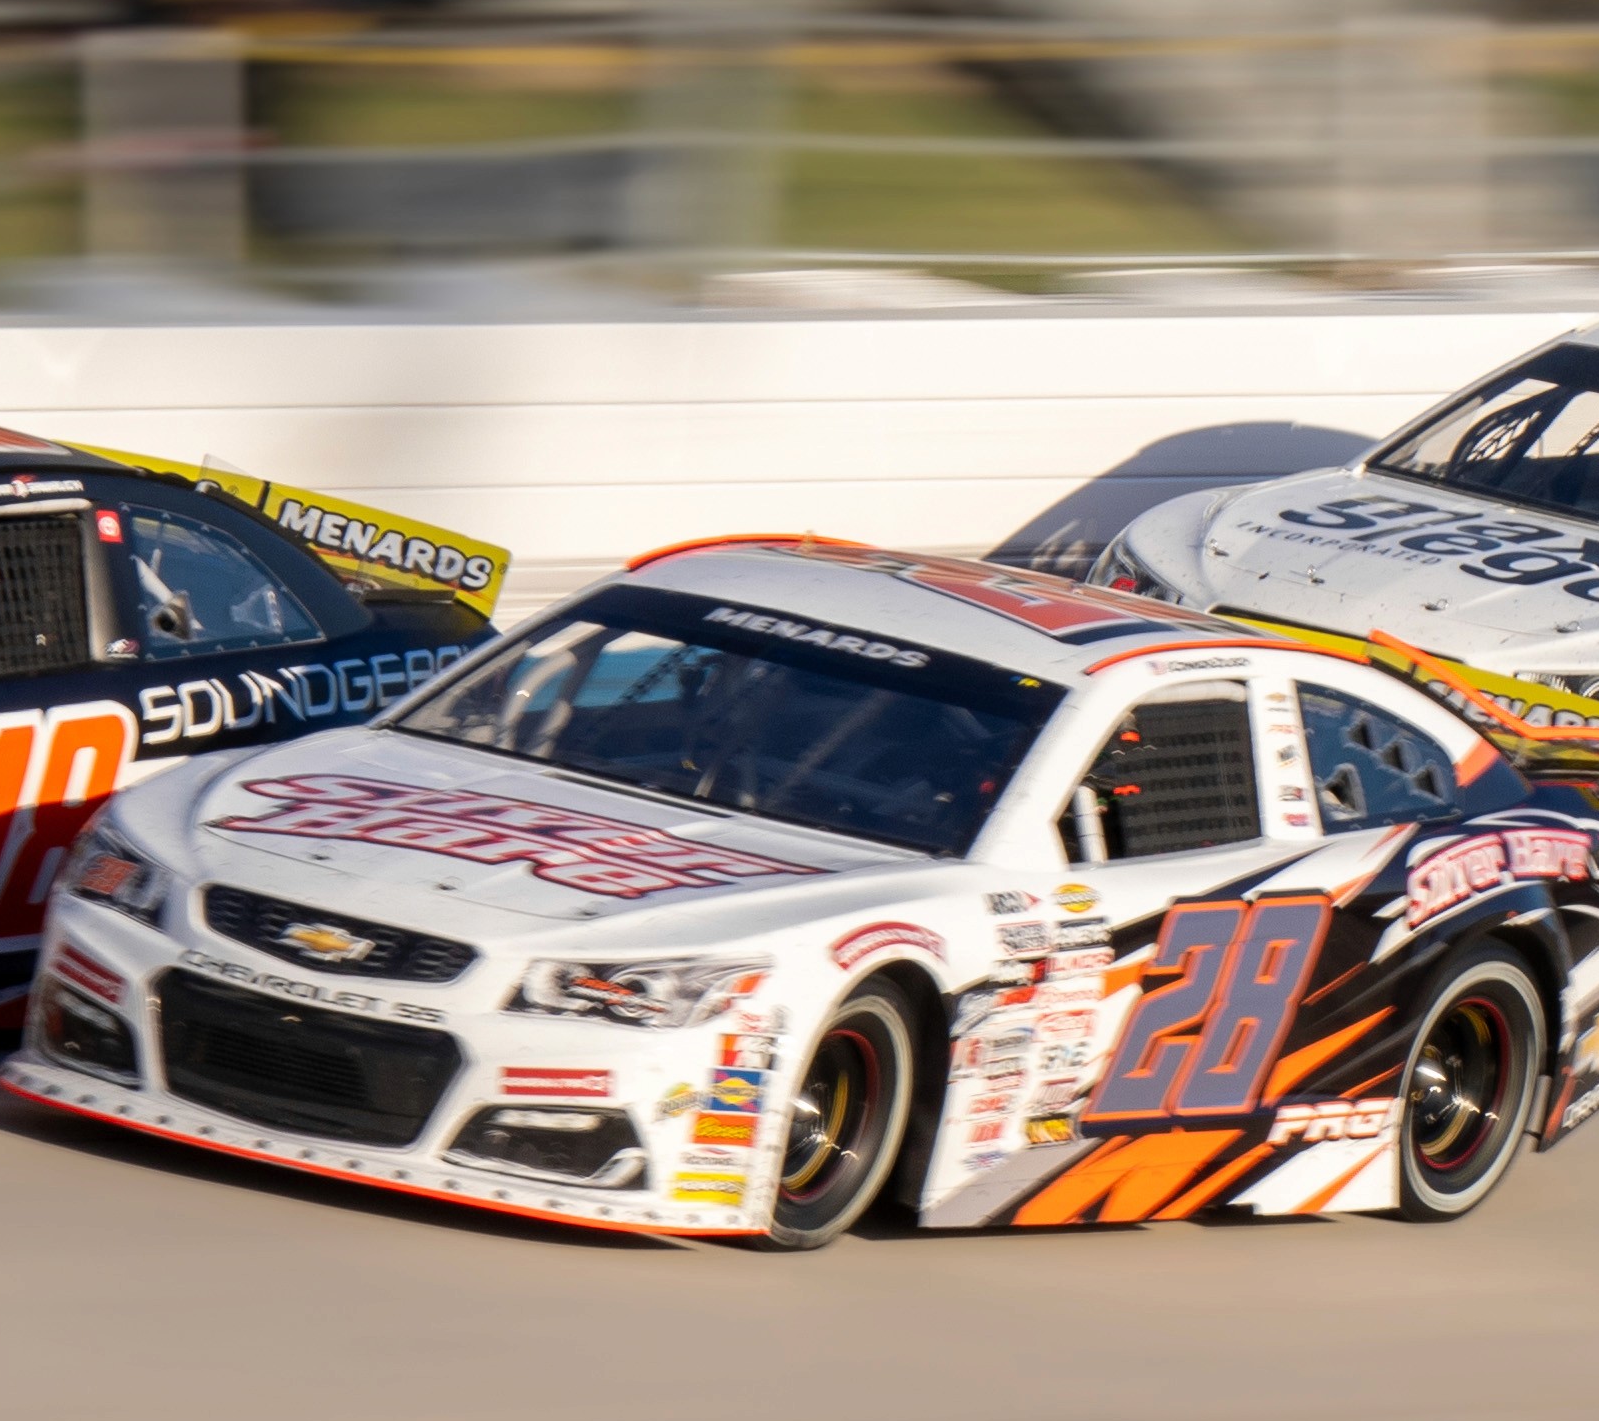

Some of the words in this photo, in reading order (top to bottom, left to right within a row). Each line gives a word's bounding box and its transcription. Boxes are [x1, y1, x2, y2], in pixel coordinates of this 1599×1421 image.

[279, 498, 493, 591] MENARDS
[1237, 521, 1441, 565] INCORPORATED
[703, 606, 931, 668] MENARDS
[1407, 832, 1506, 928] Silver
[1503, 829, 1591, 881] Hare
[178, 949, 385, 1012] CHEVROLET
[387, 1001, 449, 1024] SS
[1083, 888, 1333, 1123] 28
